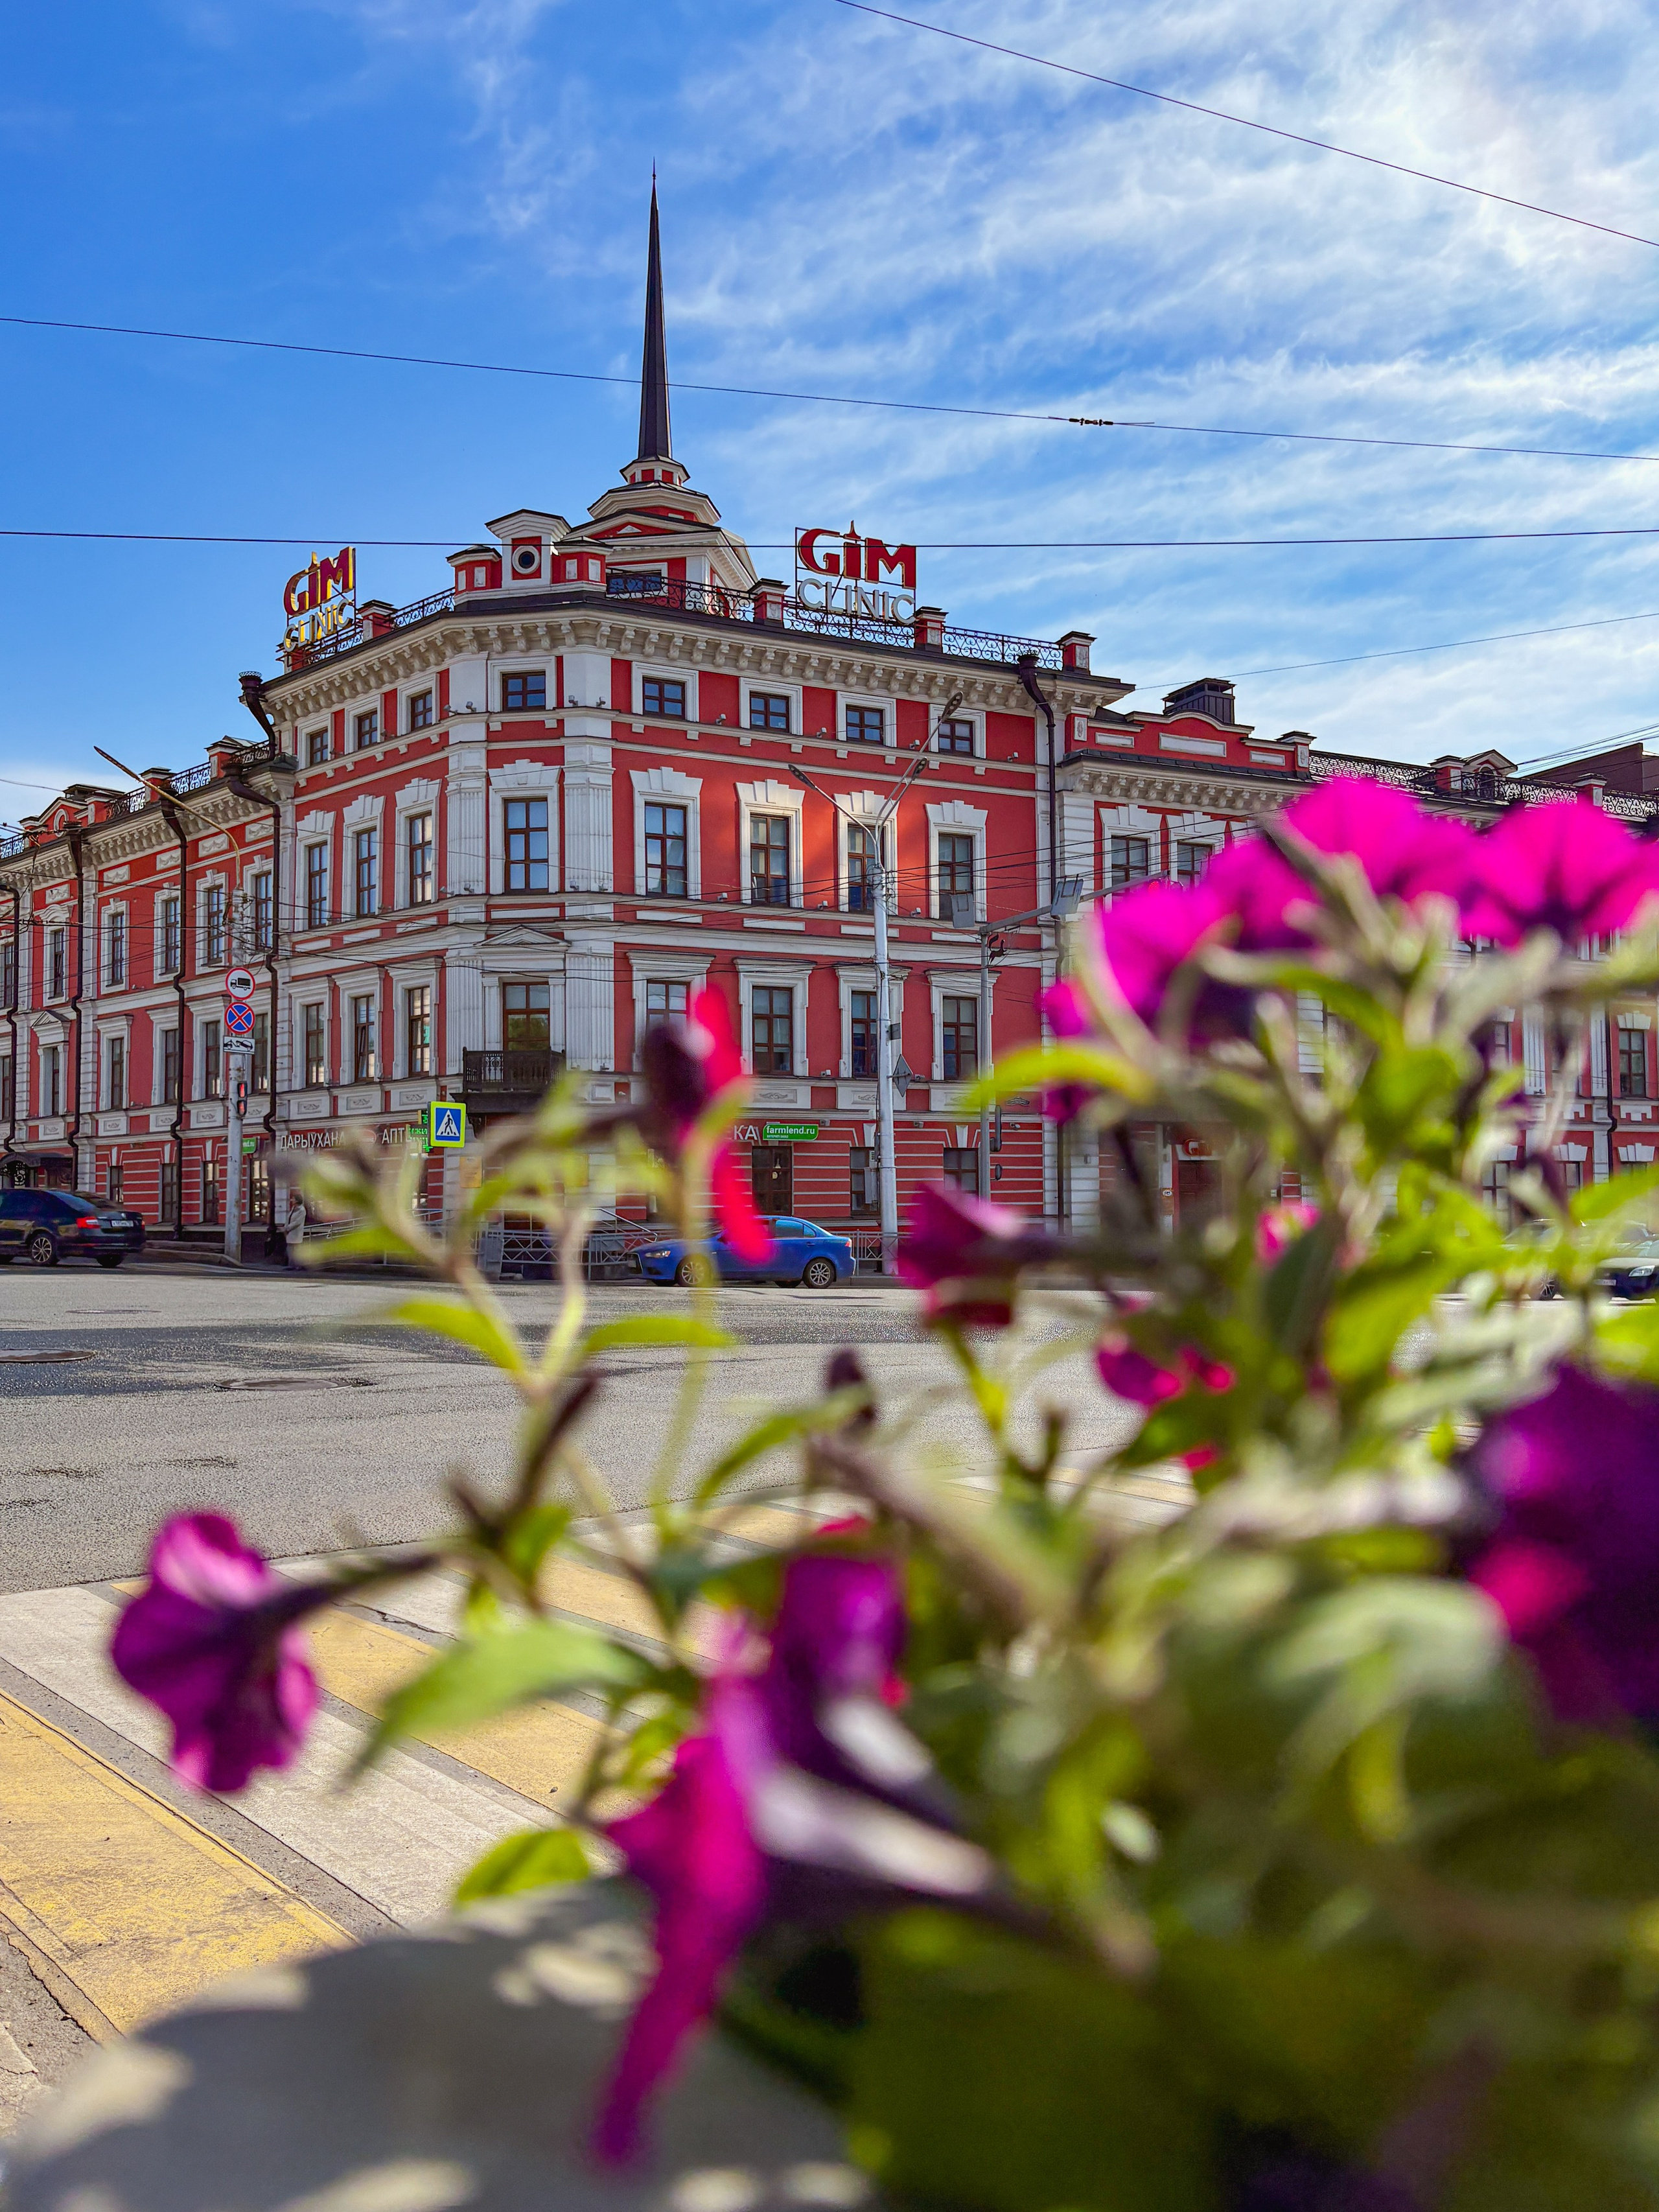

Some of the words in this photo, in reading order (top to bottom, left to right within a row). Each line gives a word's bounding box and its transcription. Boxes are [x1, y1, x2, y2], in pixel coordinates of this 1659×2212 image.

[798, 578, 916, 625] CLINIC
[283, 598, 353, 652] CLINIC
[382, 1127, 405, 1145] АПТ
[766, 1125, 815, 1135] farmlend.ru
